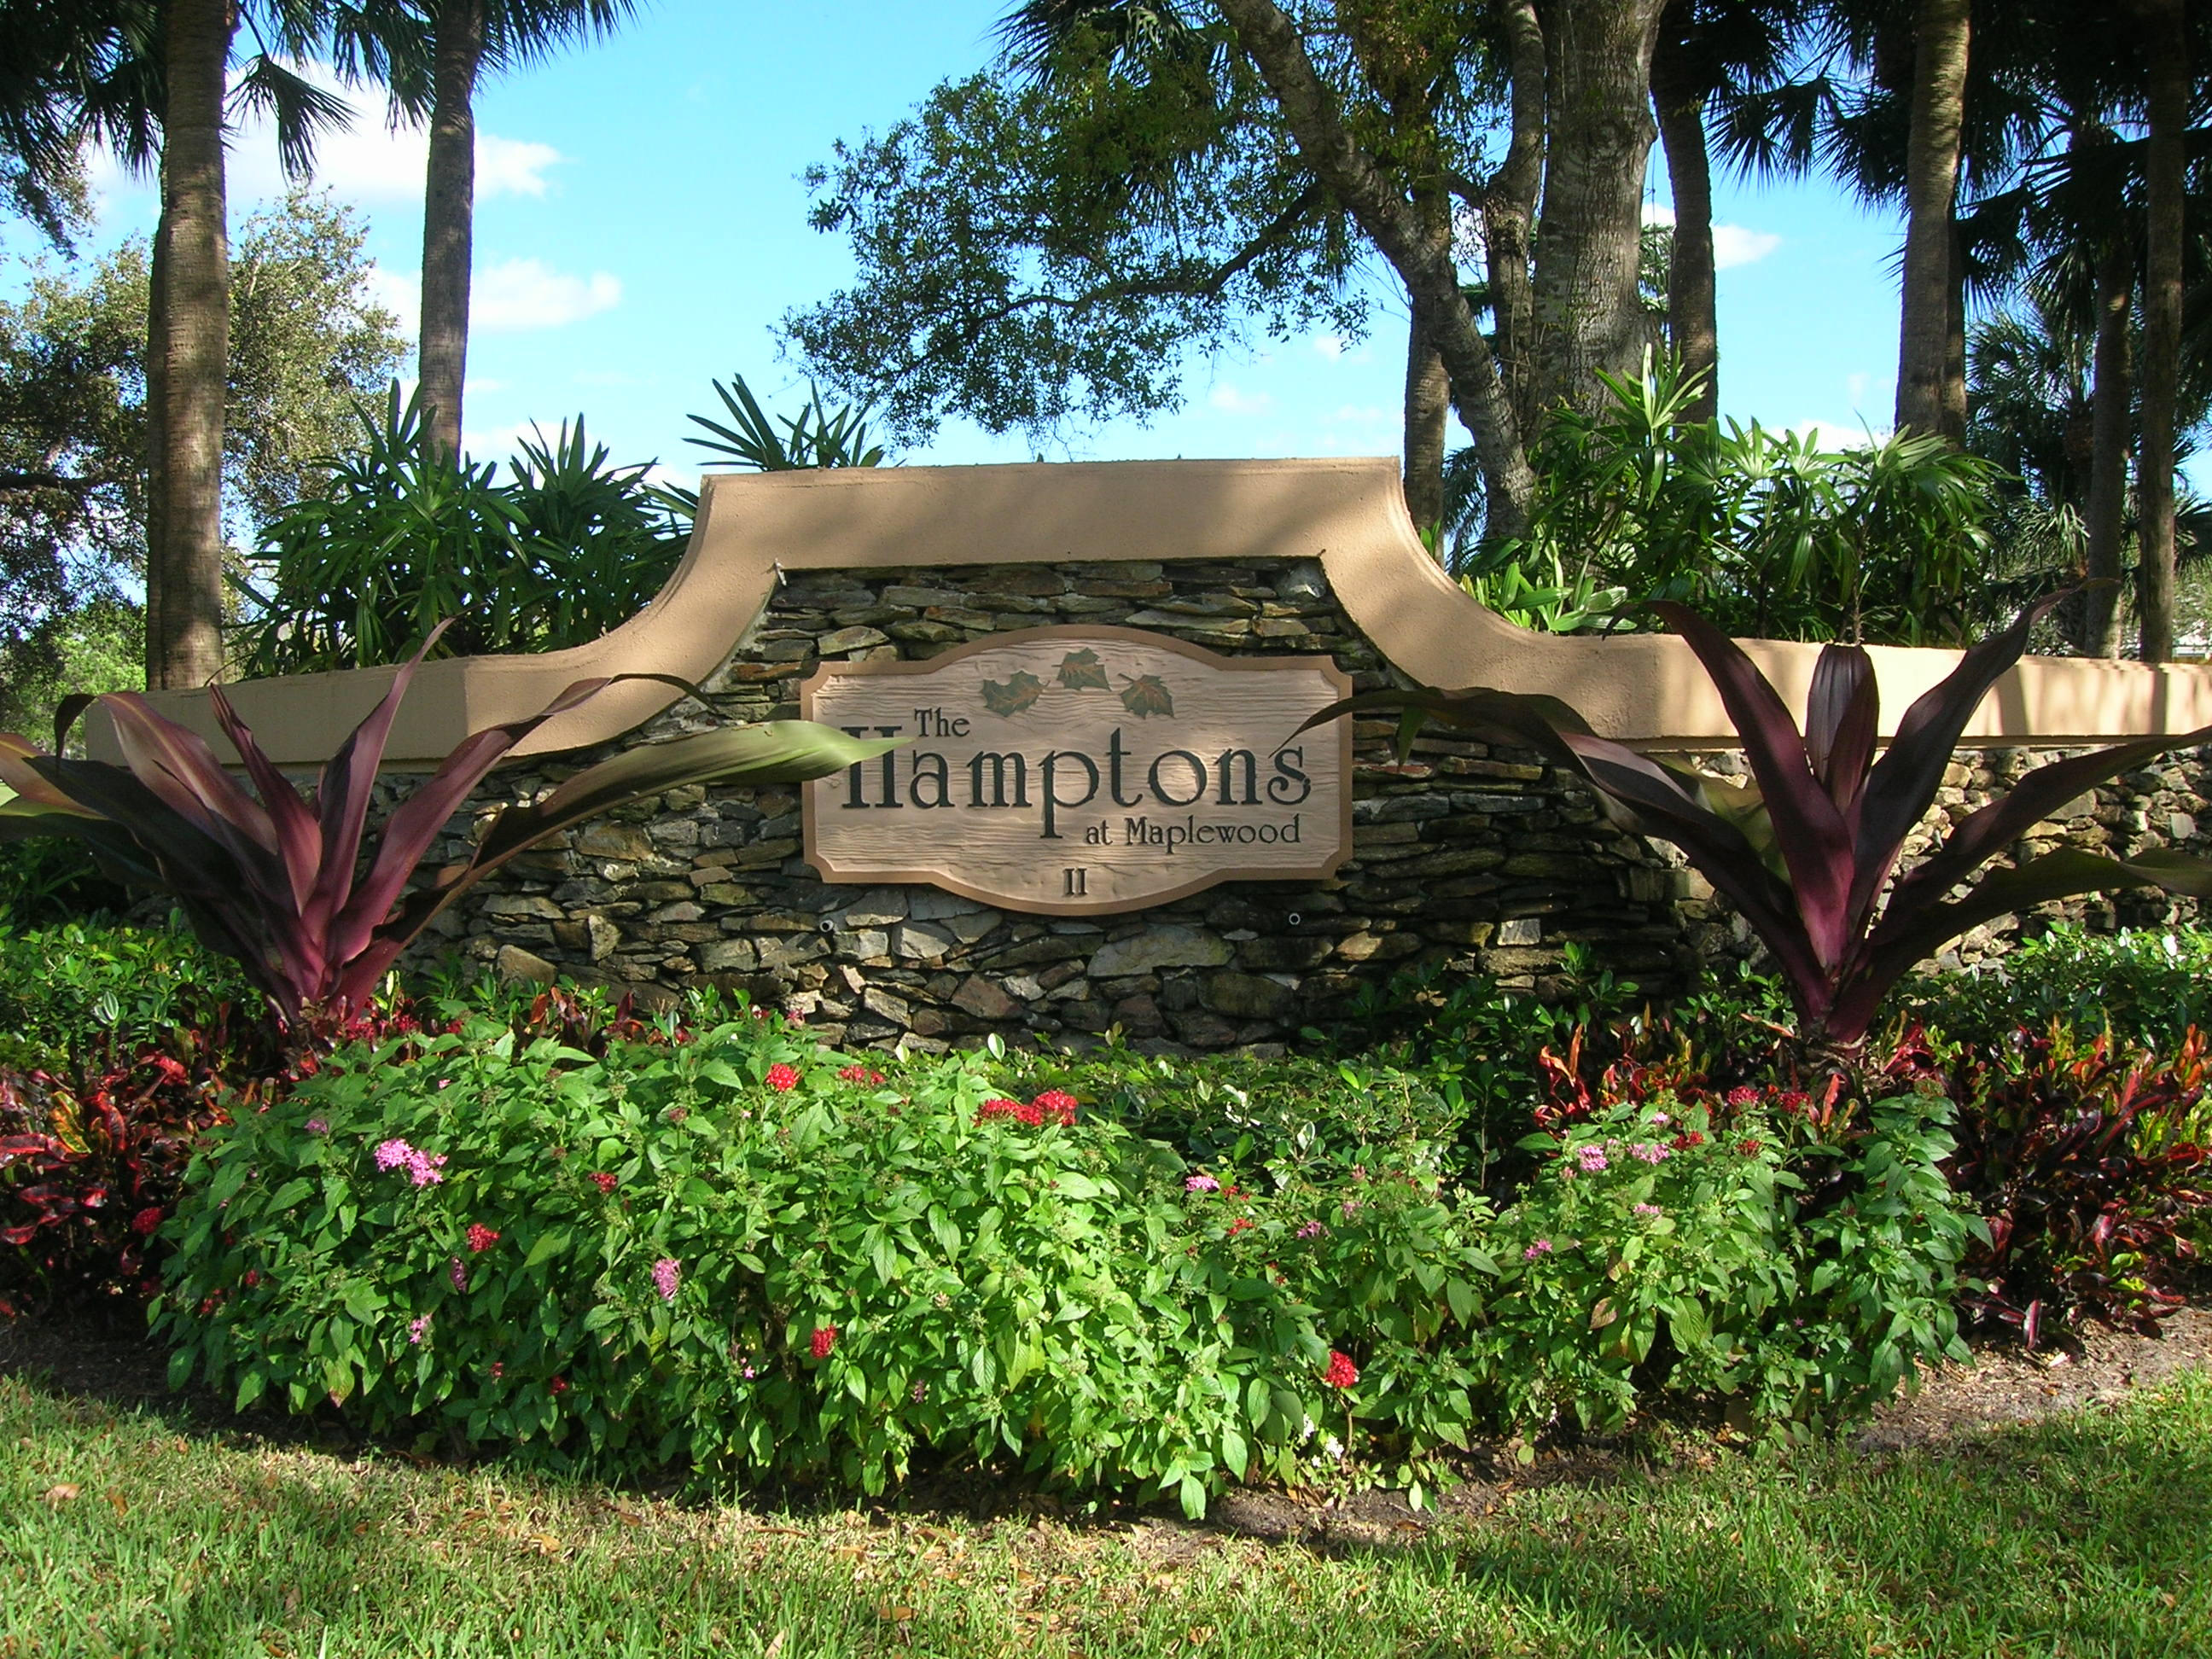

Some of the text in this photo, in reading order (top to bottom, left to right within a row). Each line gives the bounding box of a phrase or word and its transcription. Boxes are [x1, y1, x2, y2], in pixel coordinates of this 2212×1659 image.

[914, 708, 970, 737] The
[841, 725, 1313, 839] Hamptons
[1086, 814, 1301, 853] at Maplewood
[1063, 868, 1088, 896] II
